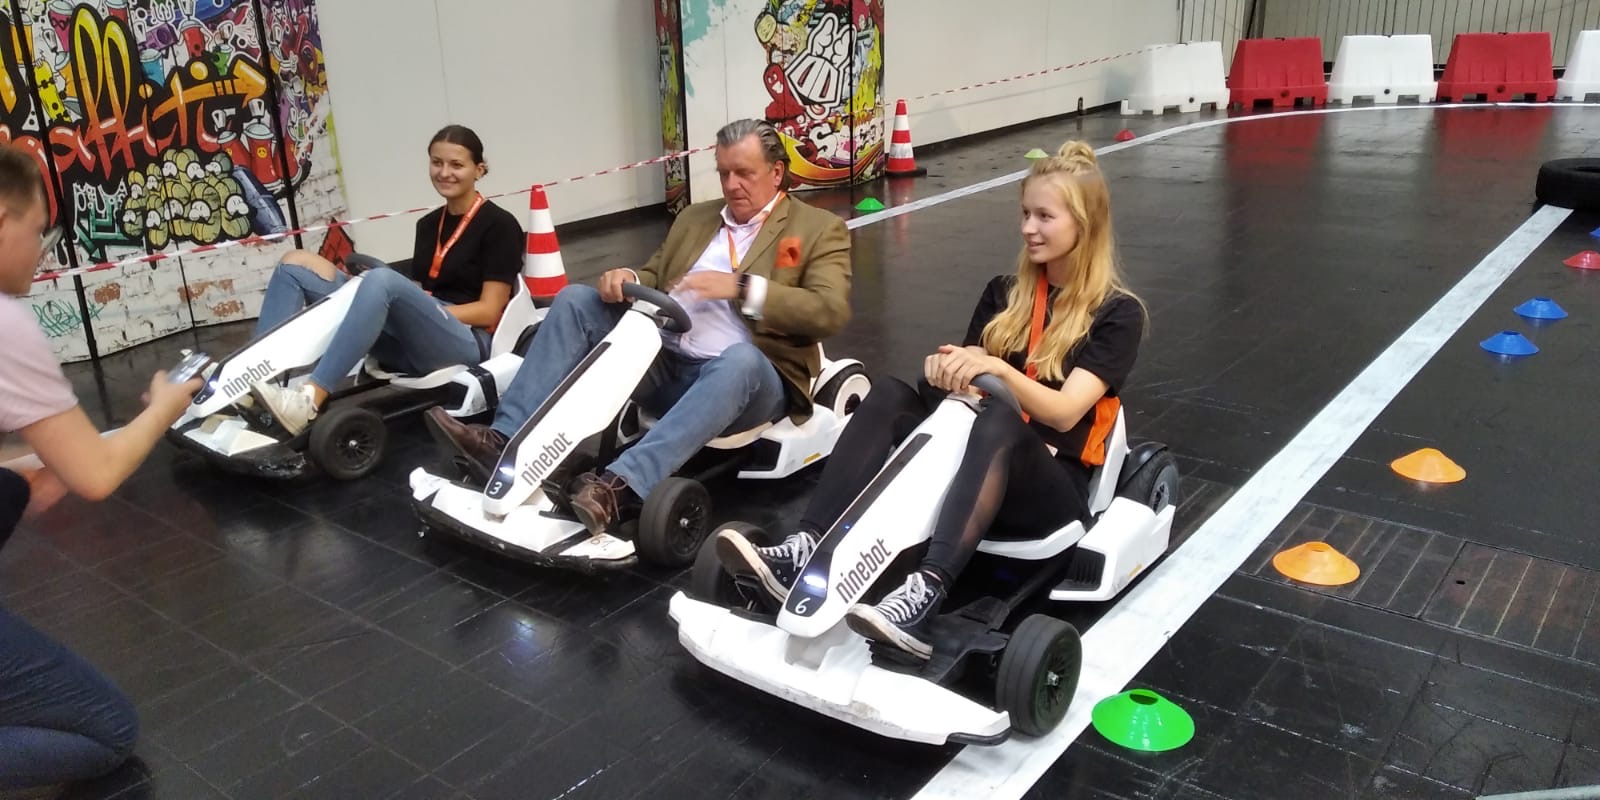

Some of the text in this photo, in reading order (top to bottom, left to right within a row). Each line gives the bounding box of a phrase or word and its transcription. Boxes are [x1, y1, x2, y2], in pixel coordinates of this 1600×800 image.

[221, 359, 277, 398] ninebot
[521, 432, 573, 486] ninebot
[489, 481, 503, 495] 3
[835, 538, 892, 604] ninebot
[795, 597, 811, 614] 6
